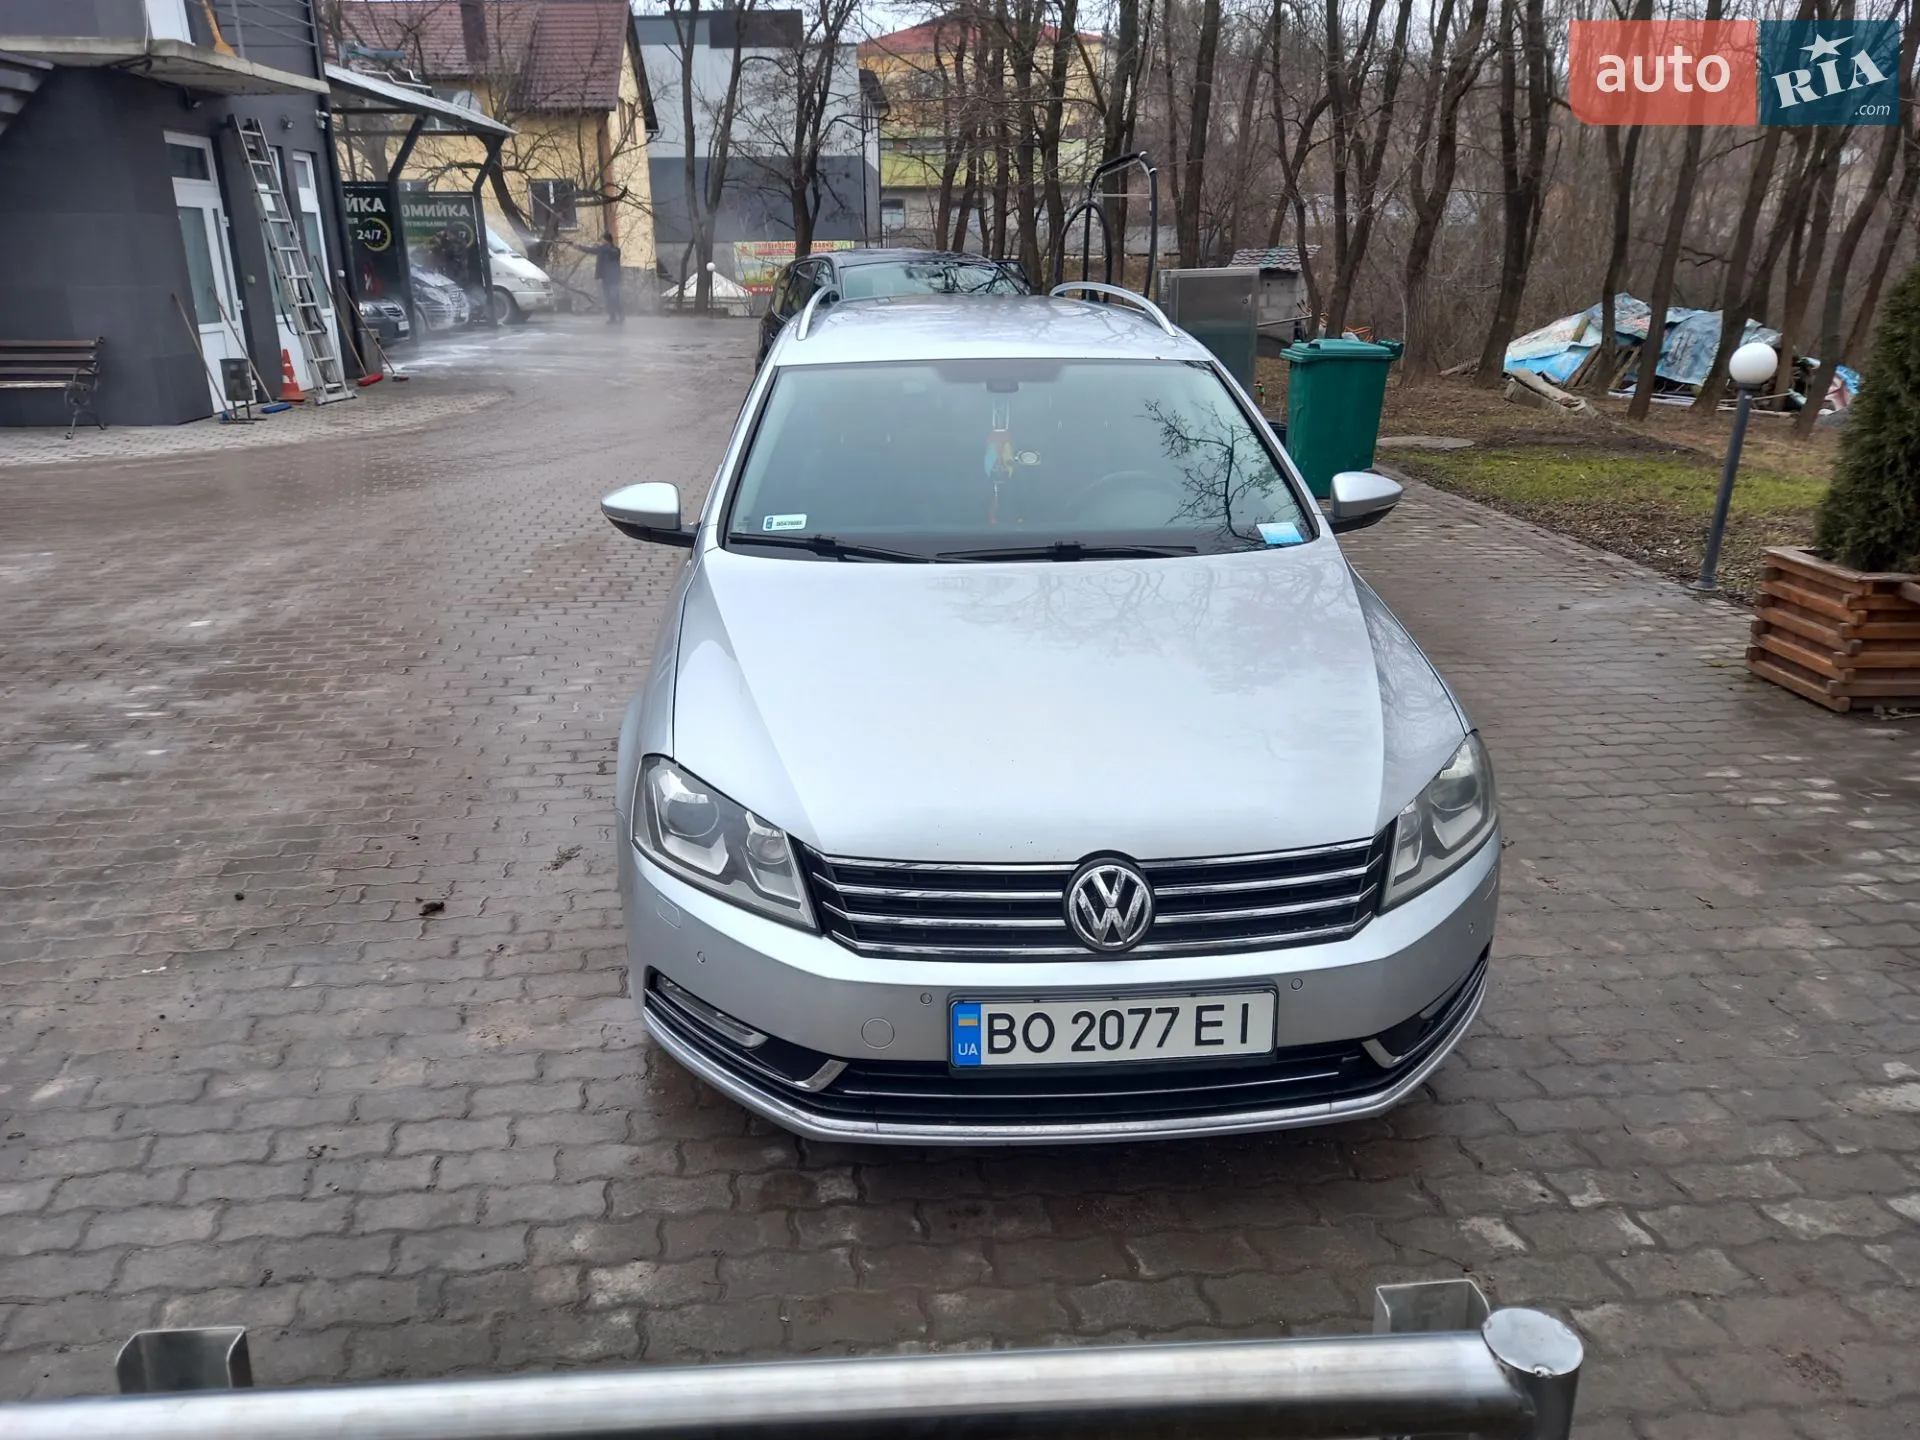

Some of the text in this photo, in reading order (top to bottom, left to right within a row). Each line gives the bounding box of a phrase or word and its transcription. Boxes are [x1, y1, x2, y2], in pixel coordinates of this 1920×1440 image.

[356, 229, 382, 240] 24/7
[987, 1011, 1055, 1055] BO
[1070, 1006, 1180, 1053] 2077
[958, 1043, 978, 1056] UA
